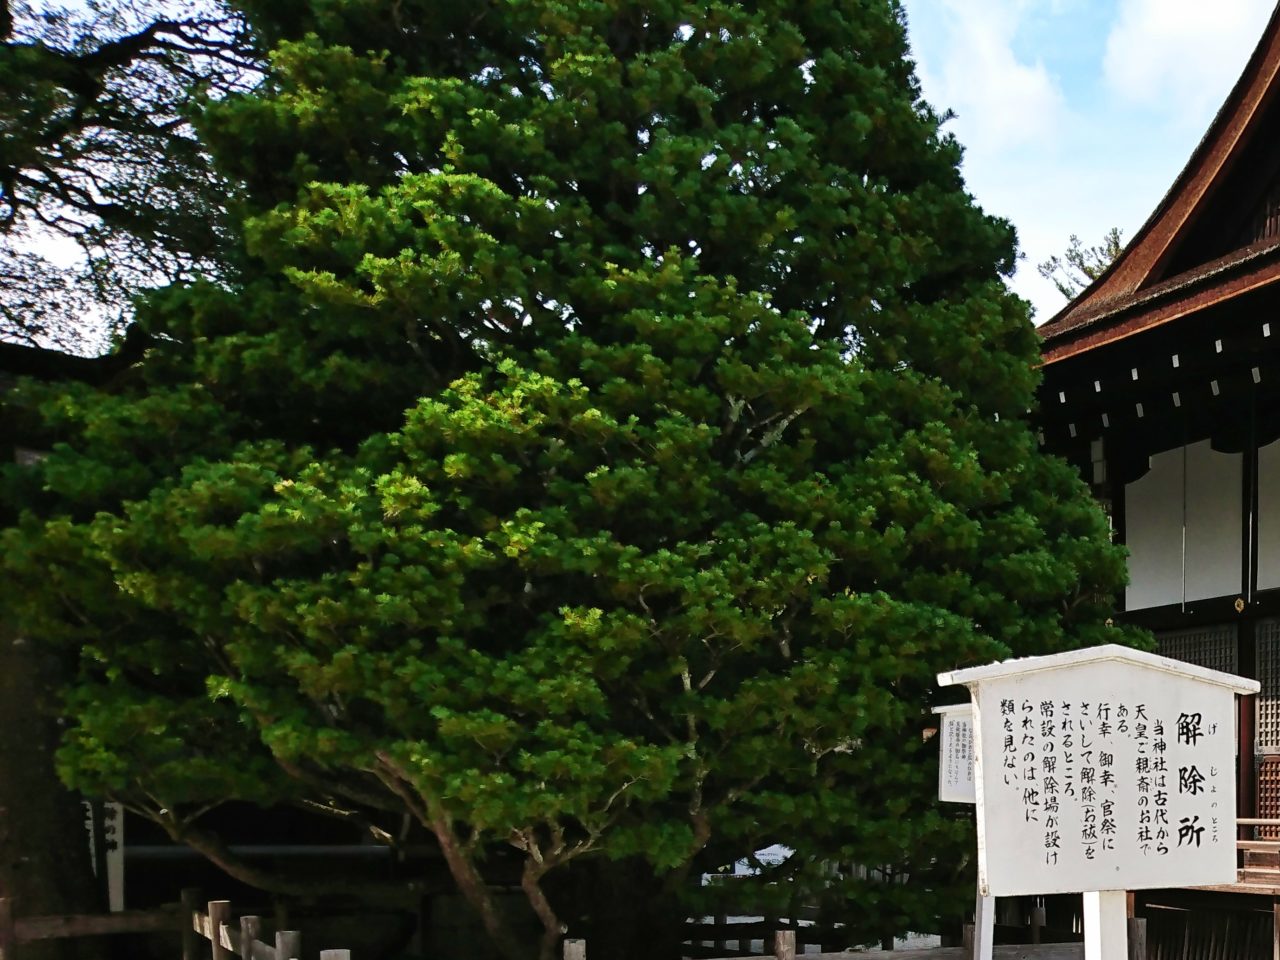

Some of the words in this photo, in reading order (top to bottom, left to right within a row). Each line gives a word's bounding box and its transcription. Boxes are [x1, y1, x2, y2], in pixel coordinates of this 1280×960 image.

[1000, 698, 1020, 791] 類を見ない。
[1021, 698, 1040, 823] られたのは、他に
[1040, 699, 1061, 866] 常設の解除場が設け
[1060, 700, 1078, 802] されるところ。
[1096, 702, 1117, 851] 行幸、御幸、官祭に
[1116, 702, 1132, 739] ある。
[1133, 703, 1153, 857] 天皇ご親斎のお社で
[1152, 718, 1169, 856] 当神社は古代から
[1175, 712, 1206, 849] 解除所
